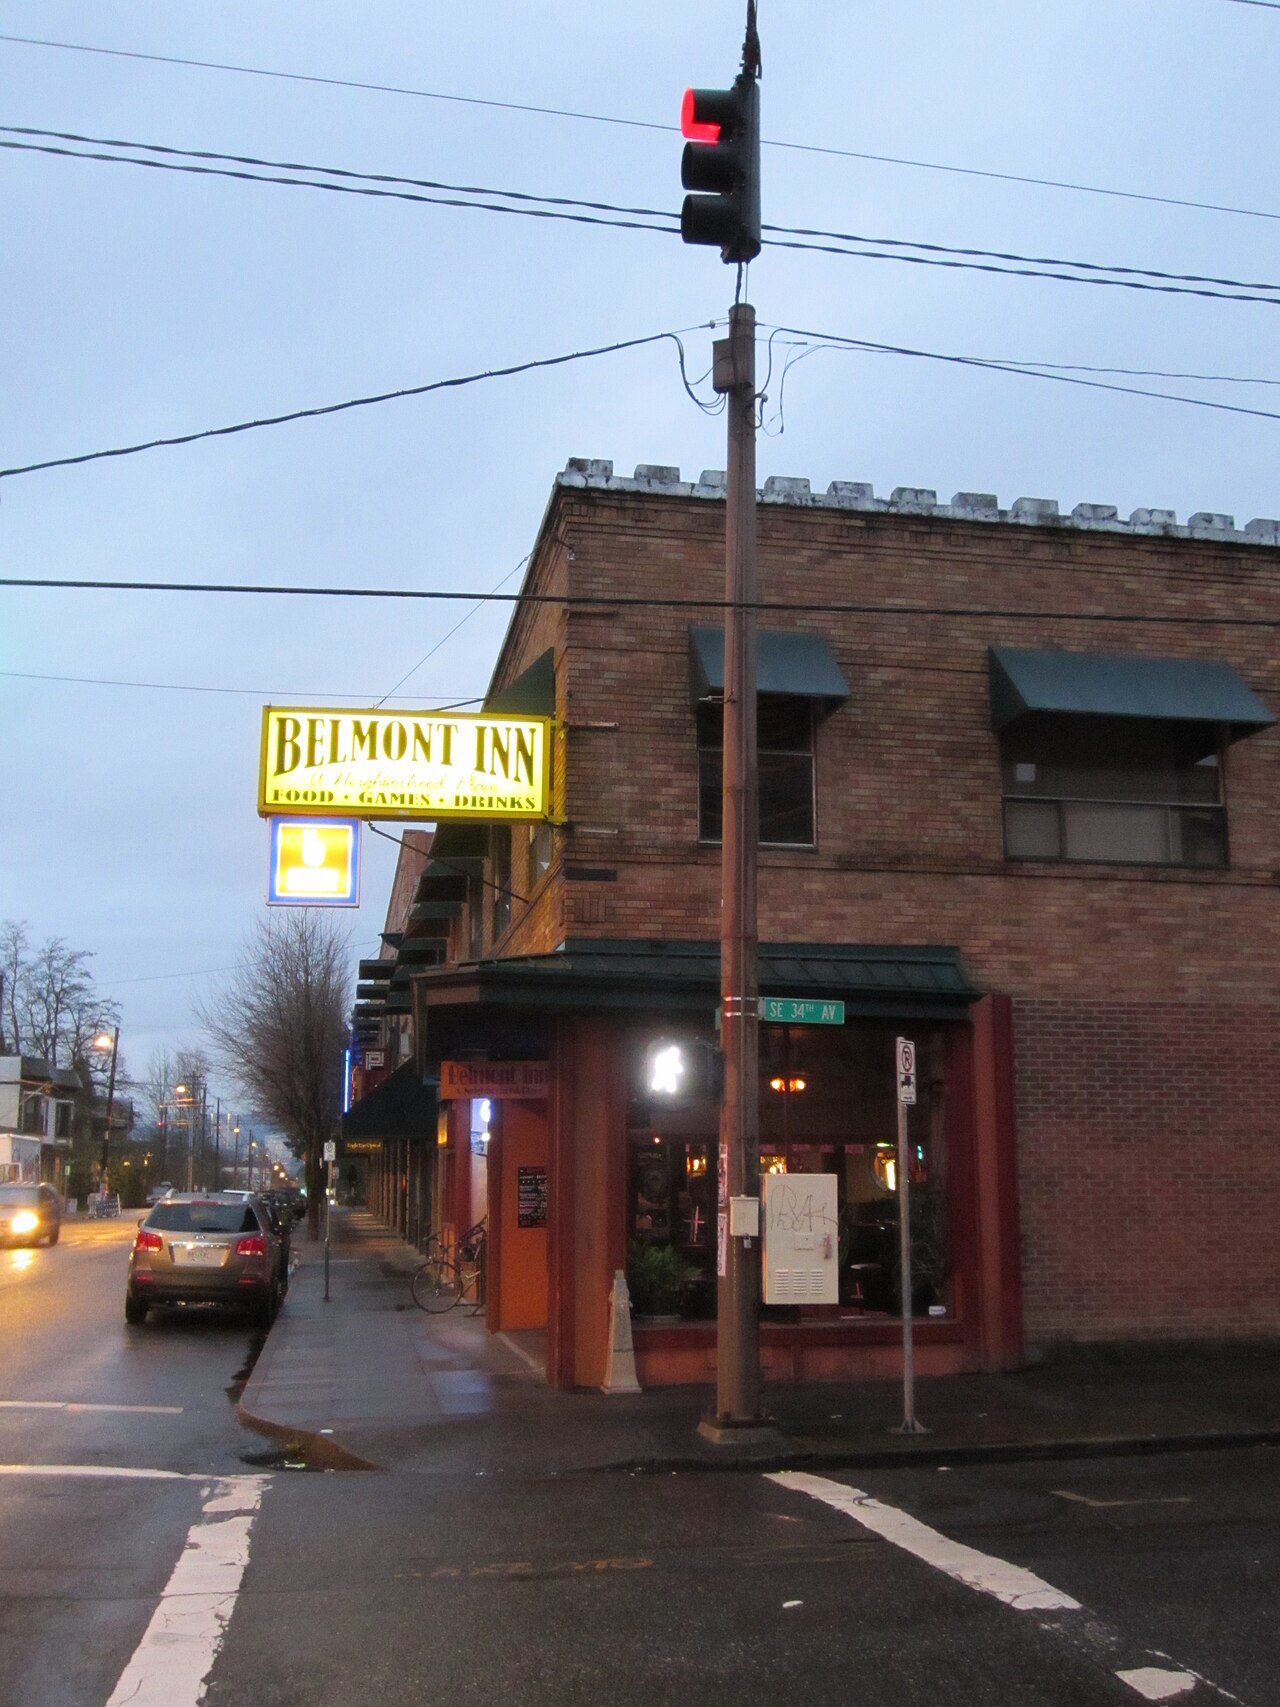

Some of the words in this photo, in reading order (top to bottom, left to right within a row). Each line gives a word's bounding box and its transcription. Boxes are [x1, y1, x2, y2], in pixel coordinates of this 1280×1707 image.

[273, 716, 458, 776] BELMONT
[474, 725, 537, 787] INN
[272, 788, 334, 804] FOOD
[358, 791, 431, 807] GAMES
[454, 794, 536, 810] DRINKS
[769, 1001, 784, 1018] SE
[821, 1004, 836, 1020] AV
